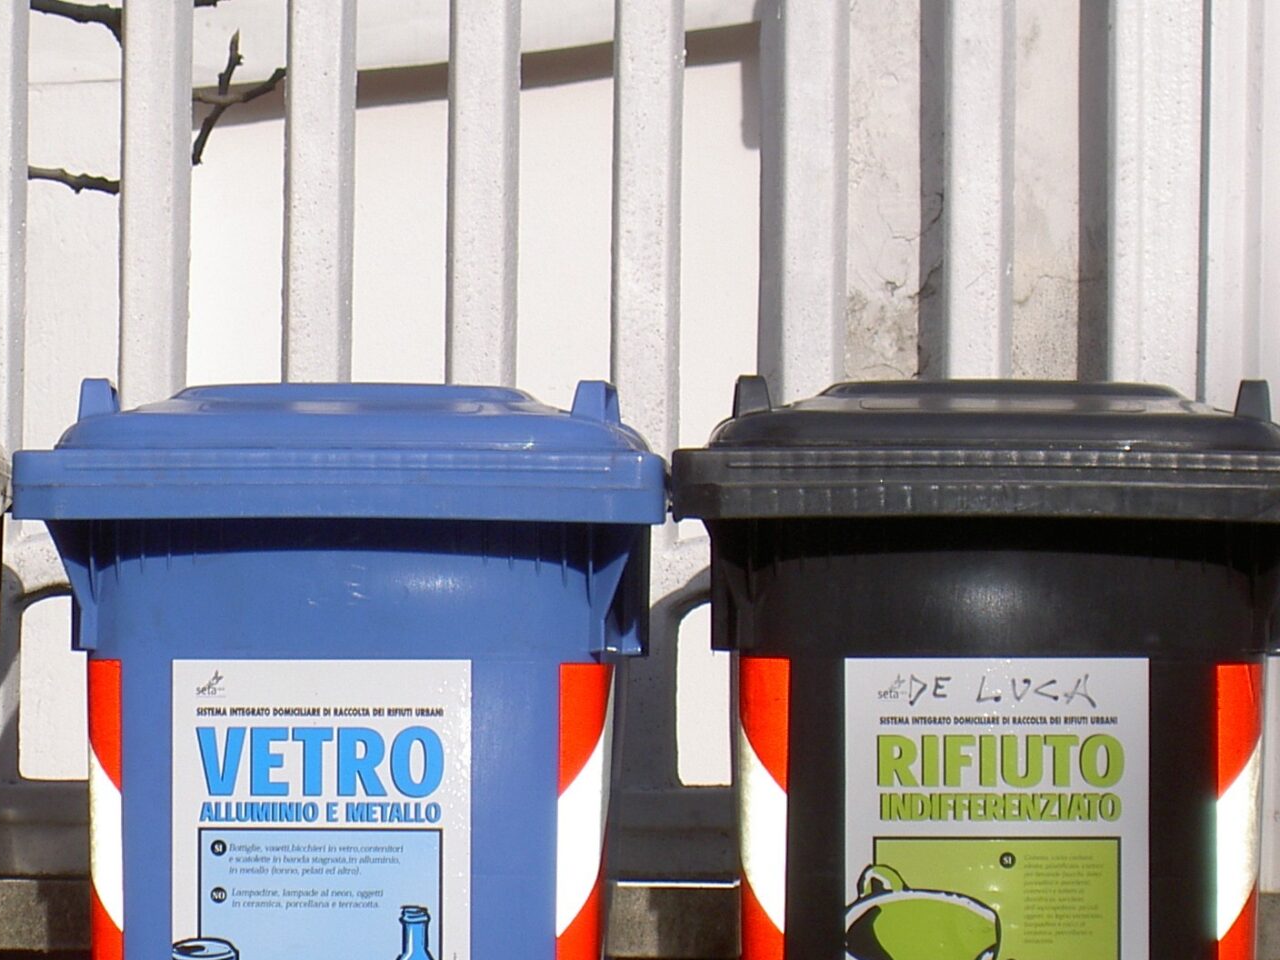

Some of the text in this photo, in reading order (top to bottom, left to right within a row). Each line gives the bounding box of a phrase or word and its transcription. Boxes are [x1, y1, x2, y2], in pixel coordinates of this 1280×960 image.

[196, 707, 444, 717] SISTEMA INTEGRATO DOMICILIARE DI RACCOLTA DEI RIFIUTI URBANI
[880, 716, 1118, 725] SISTEMA INTEGRATO DOMICILIARE DI RACCOLTA DEI RIFIUTI URBANI
[195, 725, 445, 798] VETRO
[876, 733, 1125, 788] RIFIUTO
[199, 802, 442, 823] ALLUMINIO E METALLO
[879, 792, 1122, 822] INDIFFERENZIATO
[211, 891, 226, 900] NO
